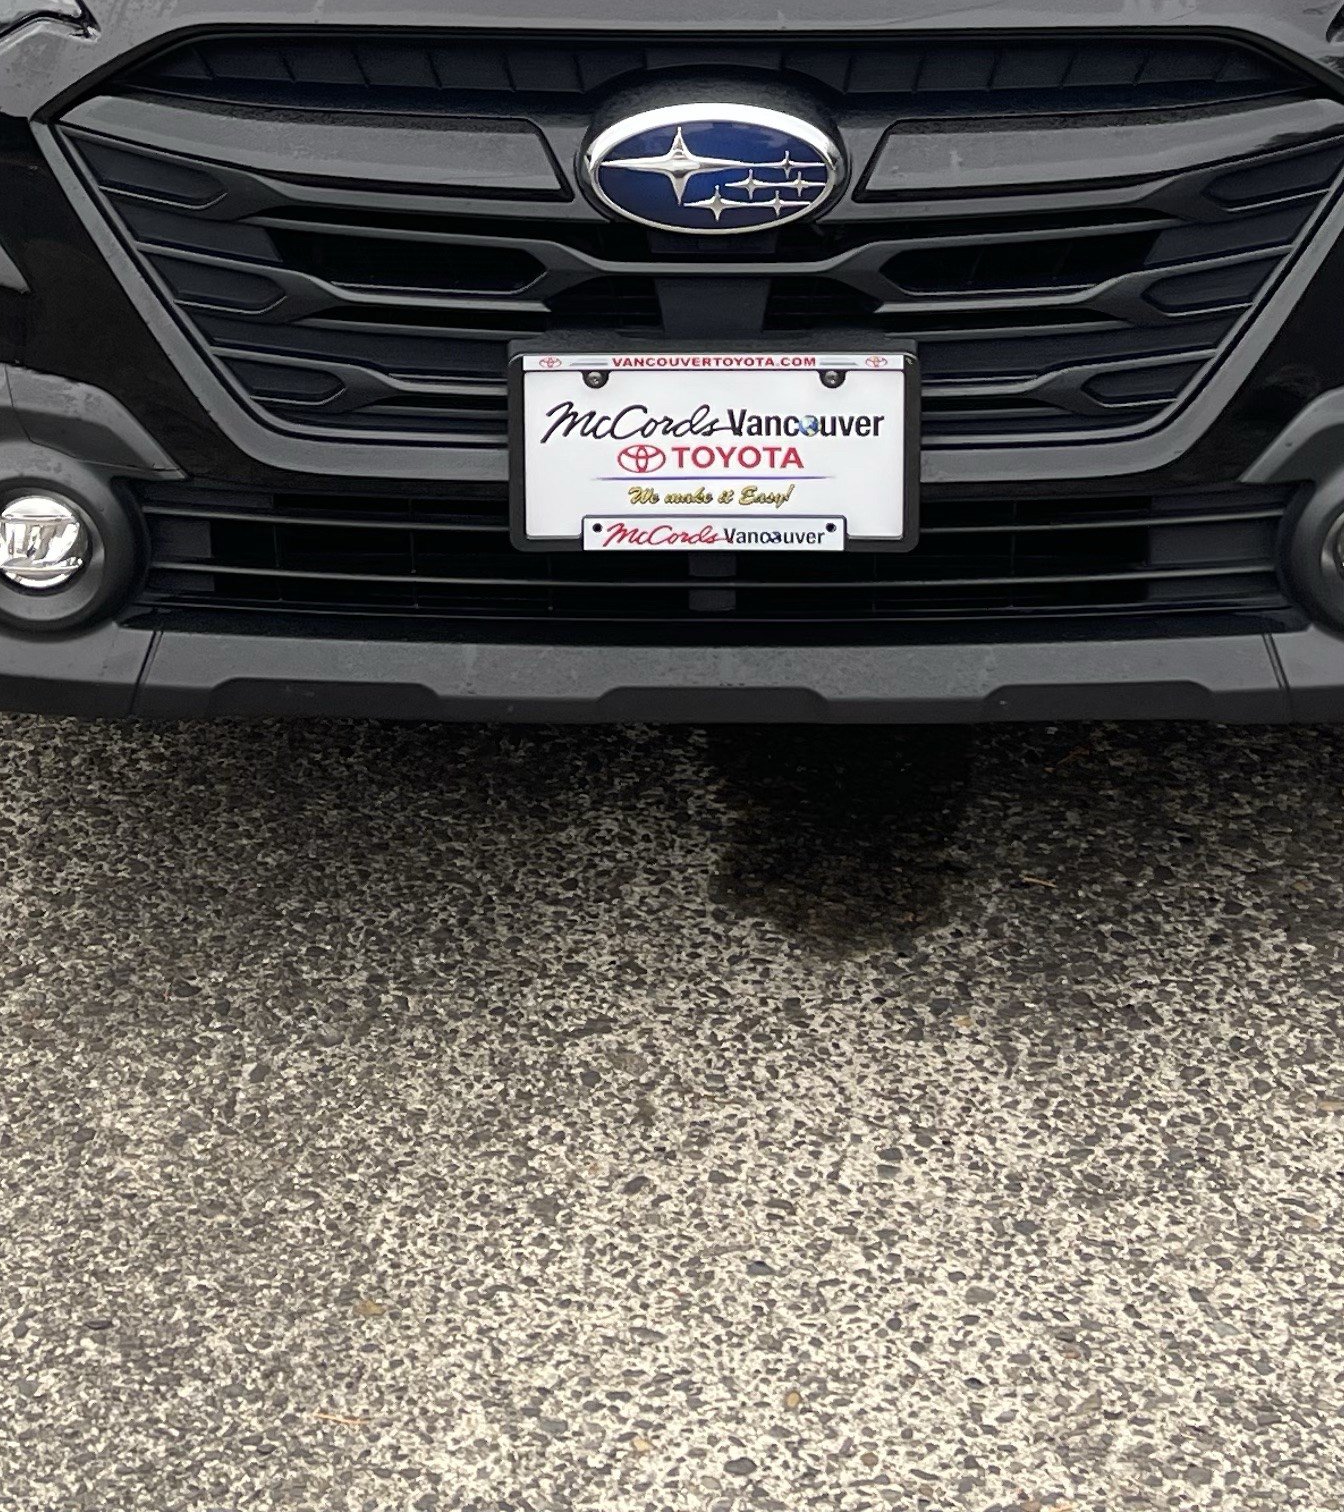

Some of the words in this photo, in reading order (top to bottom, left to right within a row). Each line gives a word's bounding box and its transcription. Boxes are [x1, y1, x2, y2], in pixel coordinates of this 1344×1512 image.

[611, 356, 817, 368] VANCOUVERTOYOTA.COM
[540, 401, 722, 444] McCords
[727, 408, 885, 438] Vancouver
[671, 446, 804, 469] TOYOTA
[628, 485, 660, 505] We
[663, 486, 714, 505] make
[738, 483, 795, 509] Easy!
[602, 523, 722, 548] McCords
